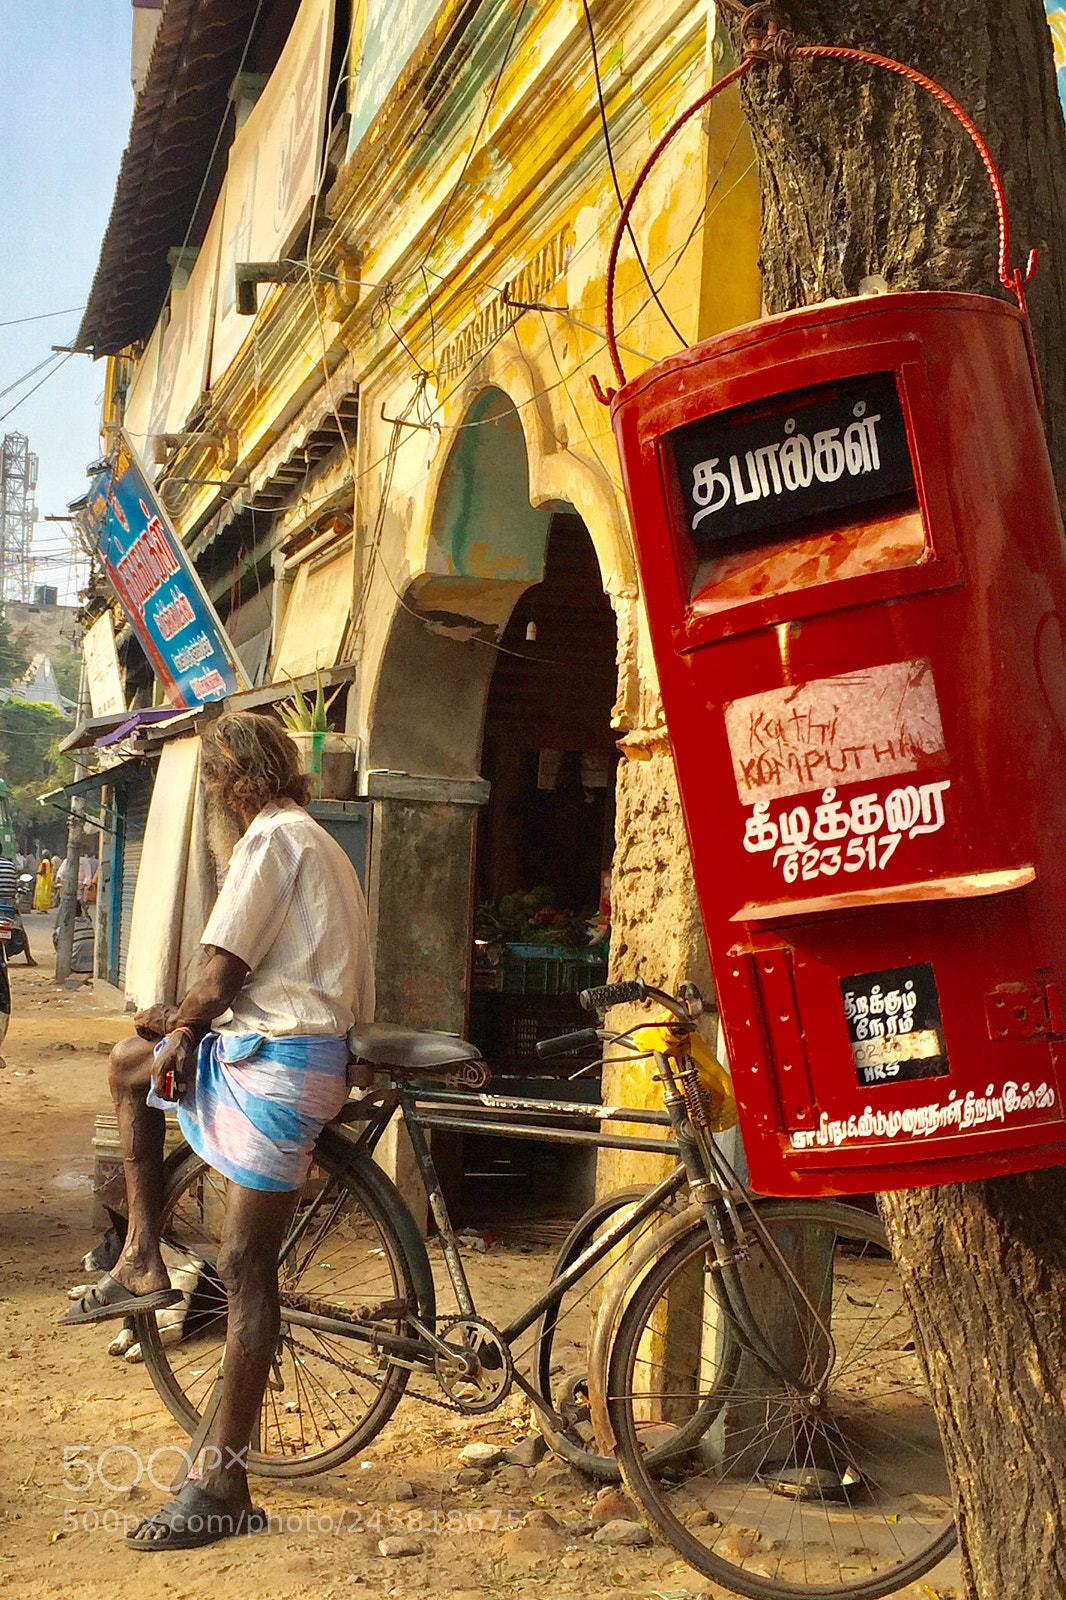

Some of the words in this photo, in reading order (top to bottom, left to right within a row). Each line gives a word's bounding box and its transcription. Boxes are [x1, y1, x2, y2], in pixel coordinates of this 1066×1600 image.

[691, 400, 881, 530] தபால்கள்
[743, 780, 951, 868] கீழக்கரை
[783, 833, 902, 883] 623517
[844, 980, 917, 1023] திறக்கும்
[854, 1010, 914, 1040] நேரம்
[863, 1060, 901, 1082] HRS
